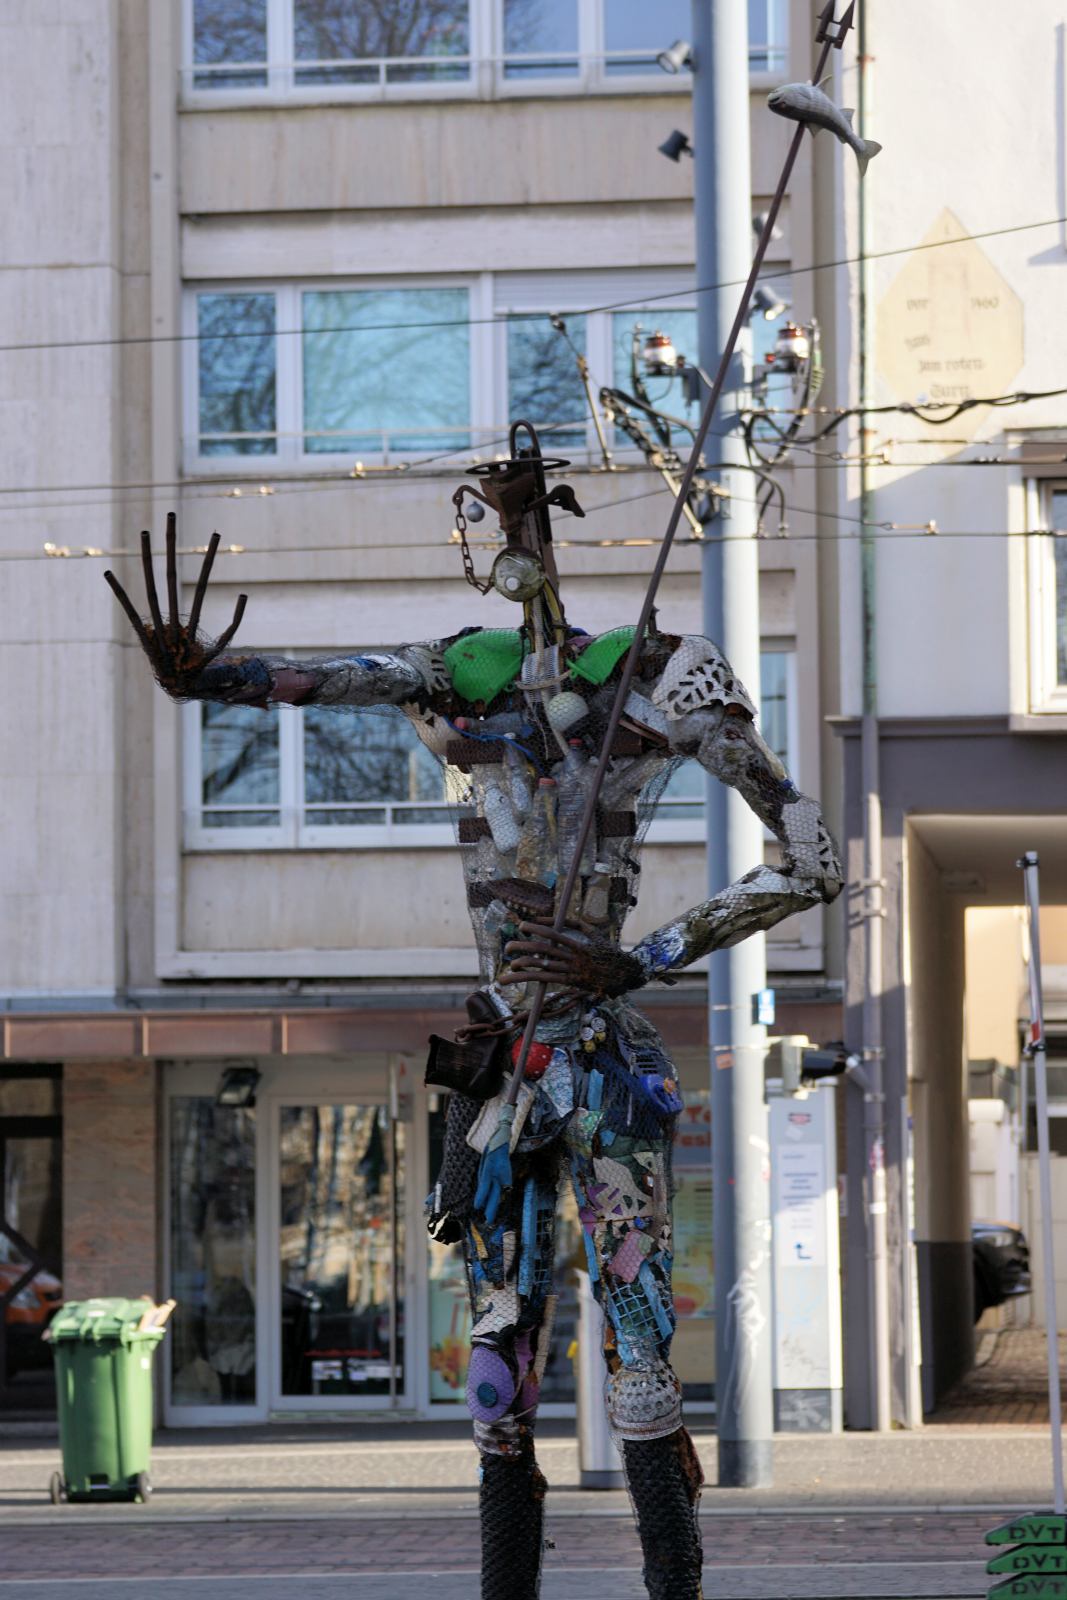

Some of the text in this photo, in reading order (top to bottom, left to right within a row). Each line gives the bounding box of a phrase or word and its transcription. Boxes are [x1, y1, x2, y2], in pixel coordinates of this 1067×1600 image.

[1009, 1524, 1063, 1540] DVT
[1013, 1553, 1066, 1569] DVT
[1012, 1579, 1066, 1596] DVT
